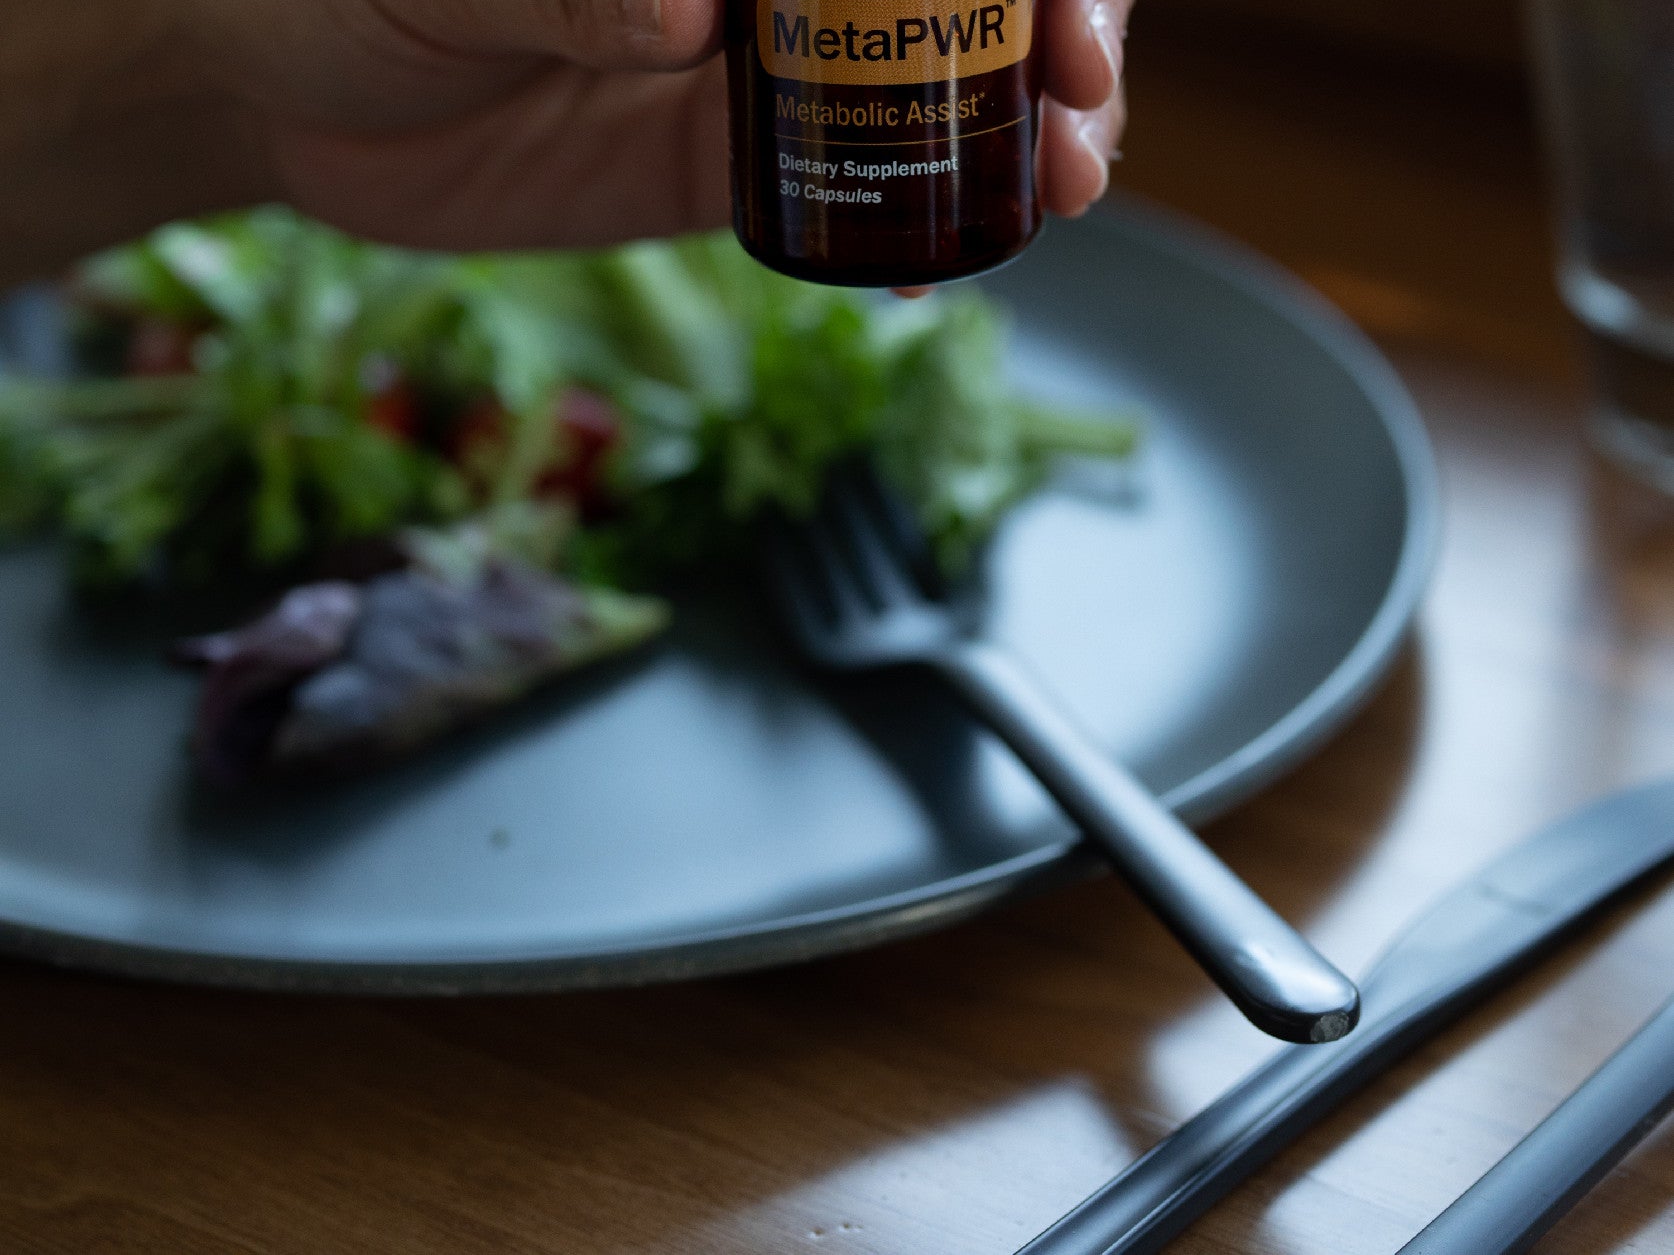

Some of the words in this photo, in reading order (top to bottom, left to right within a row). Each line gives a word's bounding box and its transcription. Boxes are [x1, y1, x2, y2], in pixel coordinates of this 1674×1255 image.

[776, 94, 899, 127] Metabolic
[779, 153, 838, 180] Dietary
[843, 155, 959, 181] Supplement
[780, 179, 800, 197] 30
[804, 184, 882, 204] Capsules
